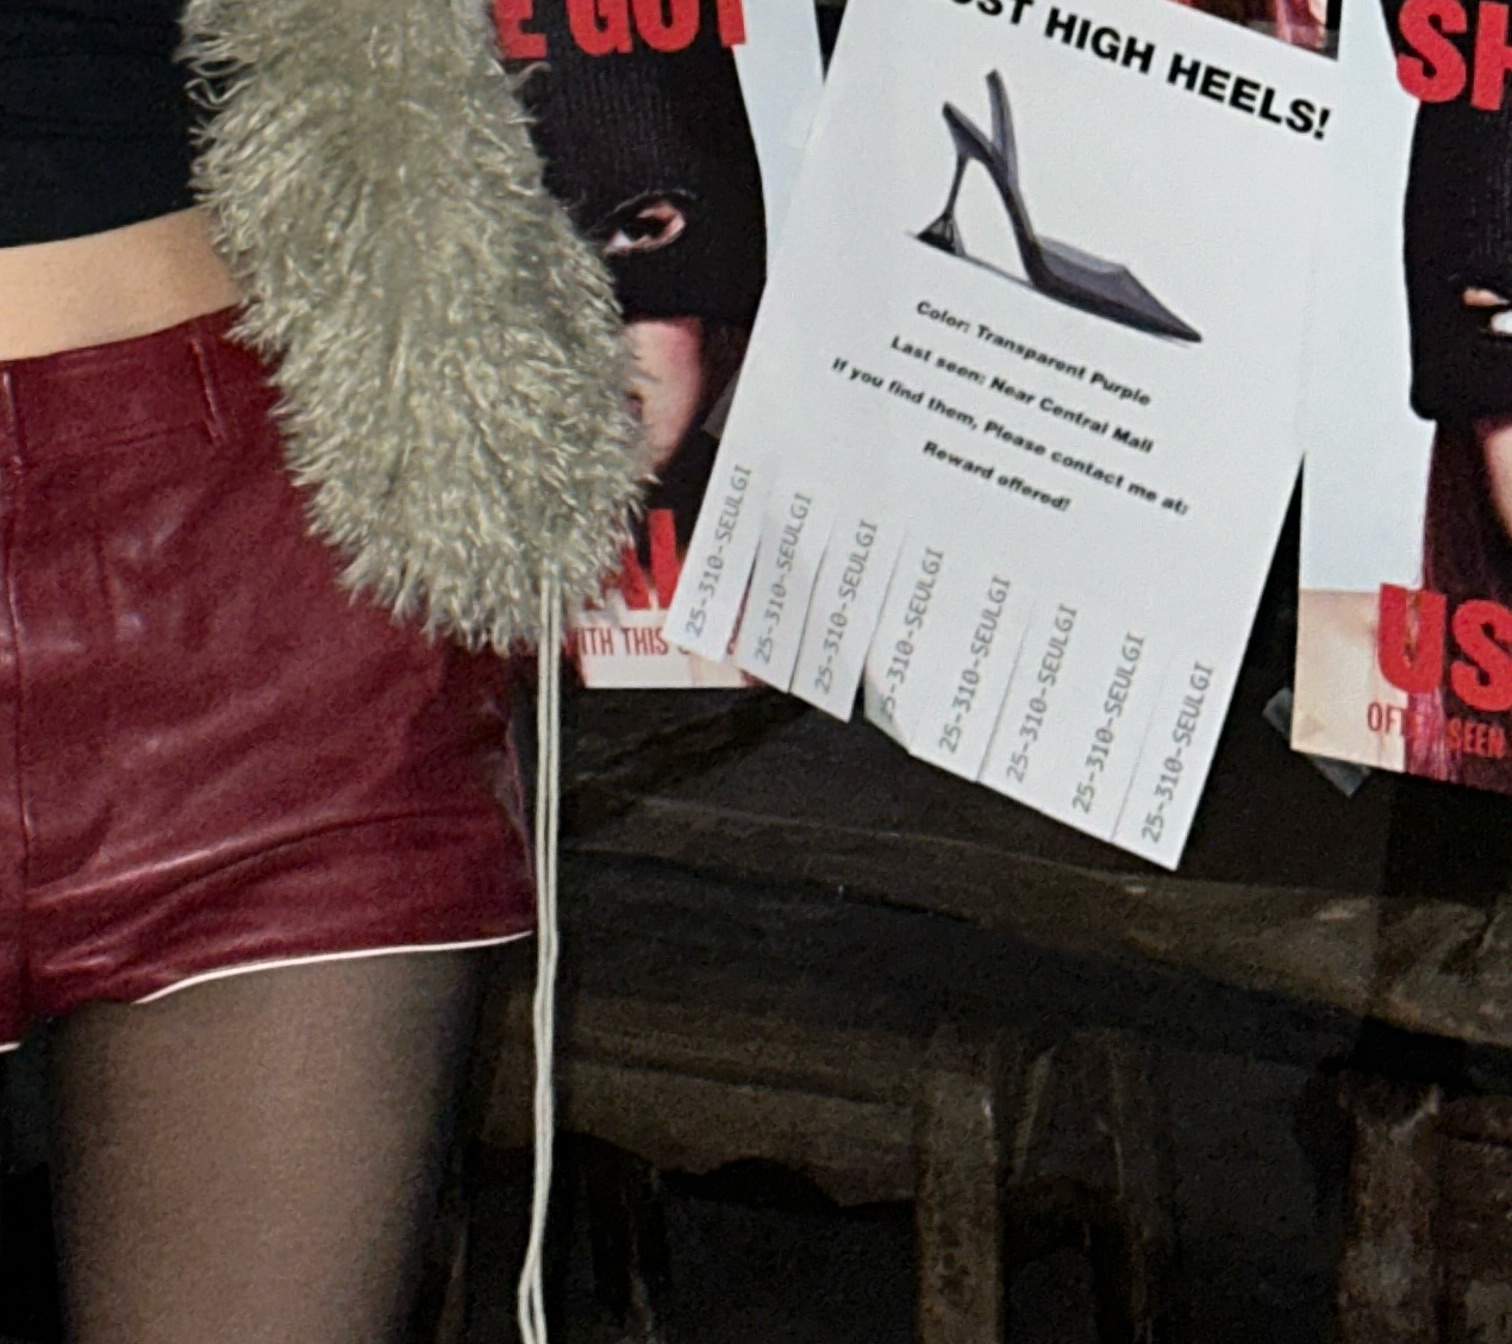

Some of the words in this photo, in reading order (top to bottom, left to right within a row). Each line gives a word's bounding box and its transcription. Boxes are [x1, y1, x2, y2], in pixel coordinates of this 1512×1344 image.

[1044, 8, 1156, 74] HIGH
[1167, 53, 1331, 140] HEELS!
[831, 357, 849, 373] If
[849, 367, 884, 389] you
[887, 380, 924, 405] find
[928, 397, 979, 430] them,
[983, 420, 1046, 457] Please
[1050, 450, 1124, 489] contact
[1127, 481, 1158, 502] me
[890, 335, 933, 363] Last
[936, 357, 987, 385] seen:
[989, 377, 1035, 405] Near
[1039, 396, 1109, 435] Central
[1111, 425, 1154, 454] Mall
[916, 300, 972, 333] Color:
[977, 325, 1086, 379] Transparent
[1090, 372, 1152, 407] Purple
[685, 464, 752, 638] 25-310-SEULGI
[922, 440, 996, 480] Reward
[997, 474, 1073, 512] offered!
[621, 626, 669, 656] THIS
[753, 493, 813, 666] 25-310-SEULGI
[814, 518, 879, 696] 25-310-SEULGI
[880, 547, 944, 723] 5-310-SEULGI
[938, 574, 1012, 755] 25-310-SEULGI
[1377, 582, 1512, 712] US
[1006, 603, 1079, 785] 25-310-SEULGI
[1072, 632, 1146, 815] 25-310-SEULGI
[1141, 661, 1215, 844] 25-310-SEULGI
